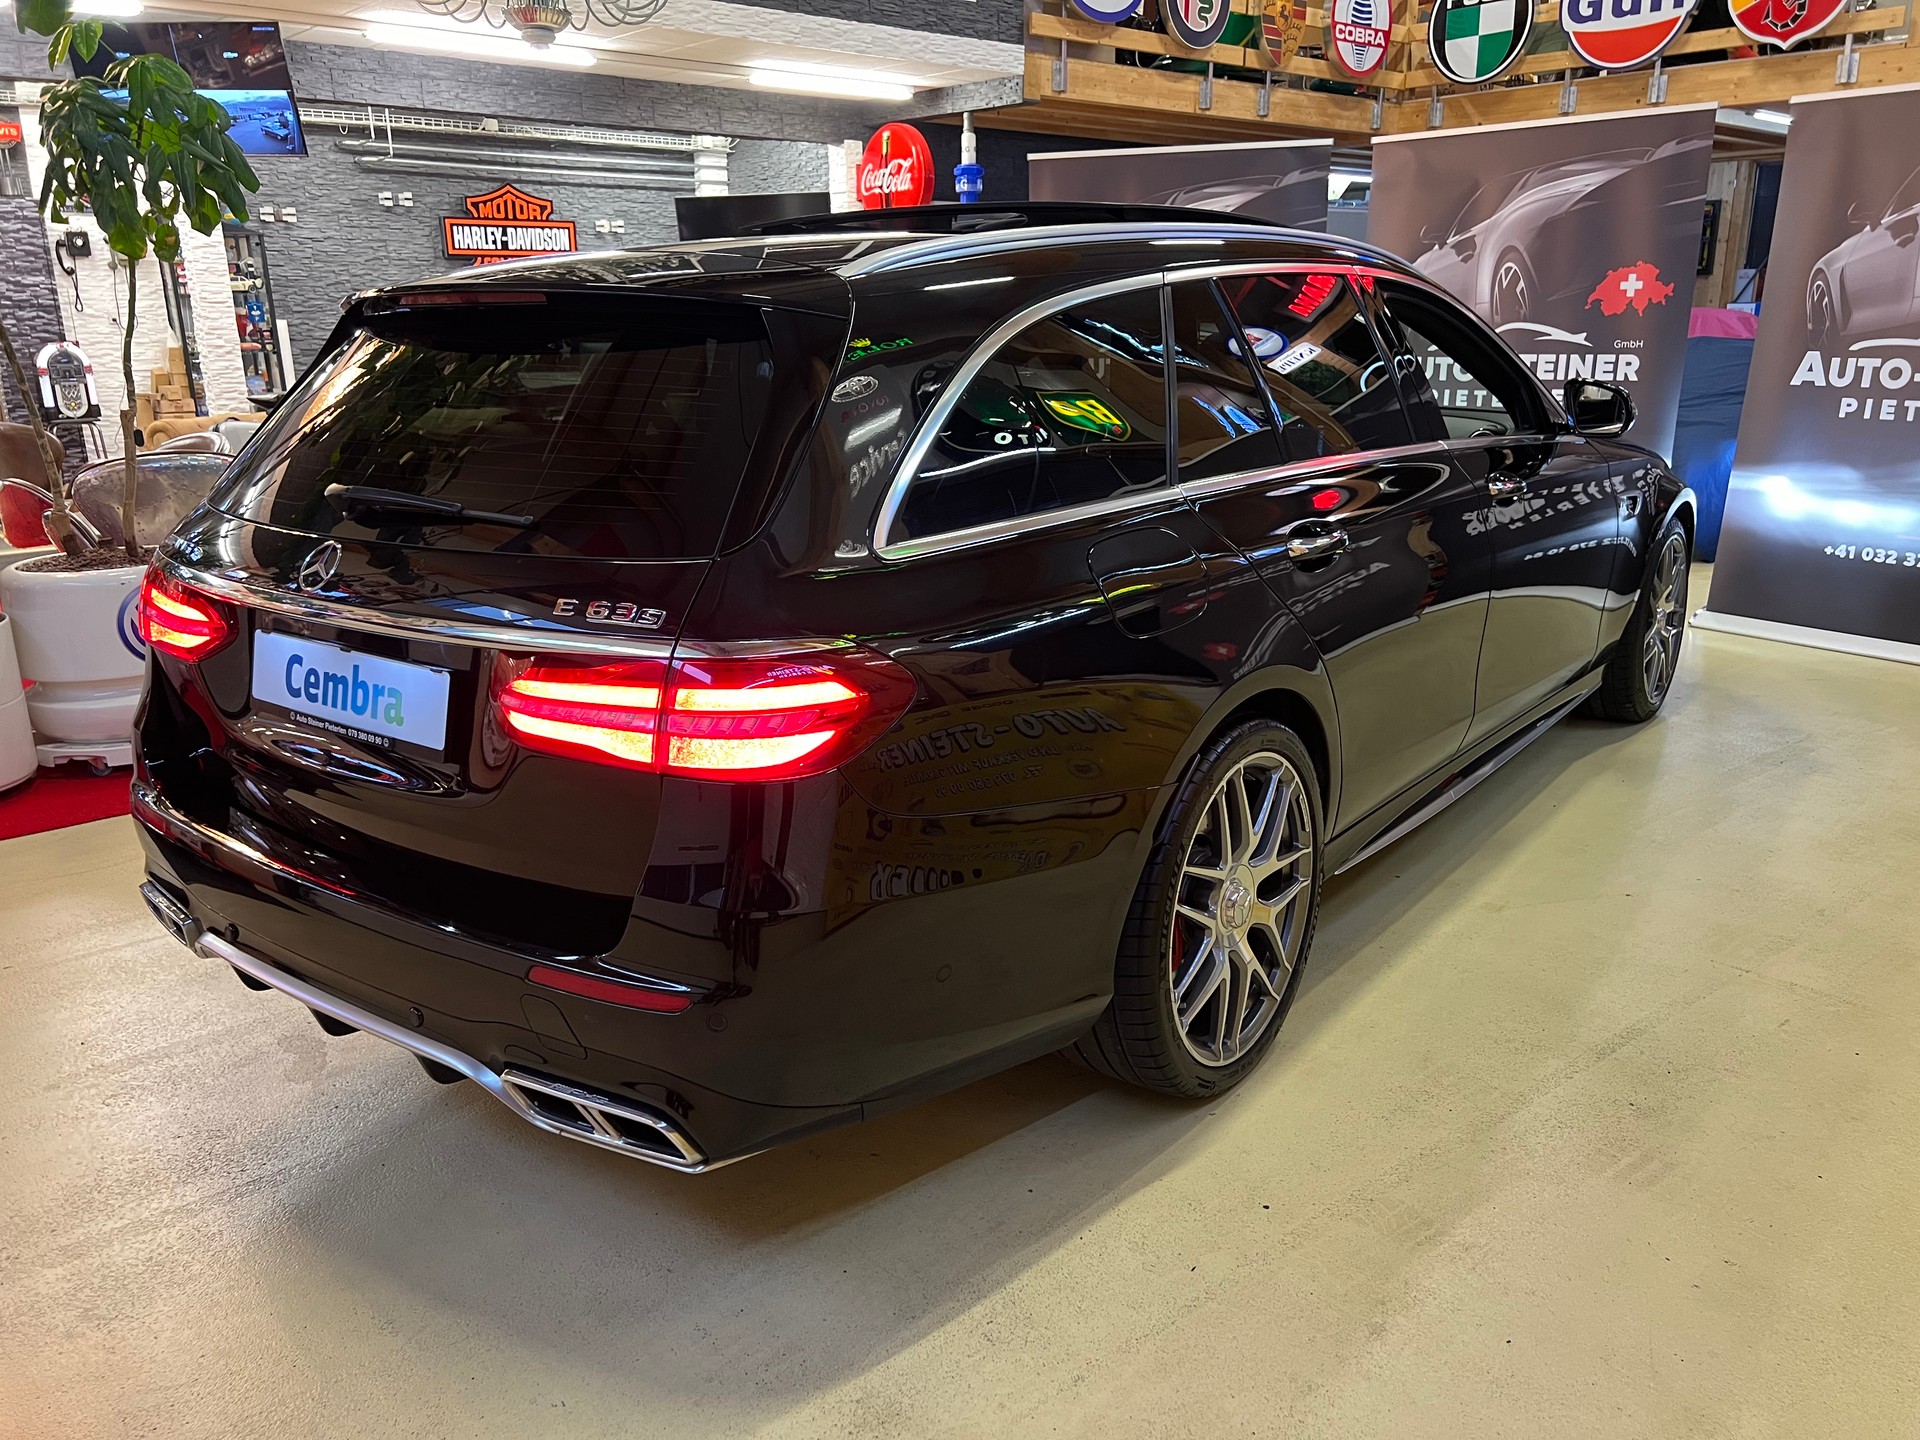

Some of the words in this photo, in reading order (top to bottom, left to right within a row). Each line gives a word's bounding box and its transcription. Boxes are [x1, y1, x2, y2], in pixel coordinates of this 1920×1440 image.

[1336, 24, 1385, 47] COBRA
[479, 192, 541, 220] MOTOR
[452, 225, 570, 251] HARLEY-DAVIDSON
[1614, 340, 1644, 349] GmbH
[1824, 544, 1856, 559] +41
[1861, 547, 1897, 565] 032
[553, 598, 579, 616] E
[285, 653, 405, 727] Cembra
[296, 714, 307, 724] Auto
[348, 728, 358, 738] 079
[1160, 849, 1184, 953] MICHELIN
